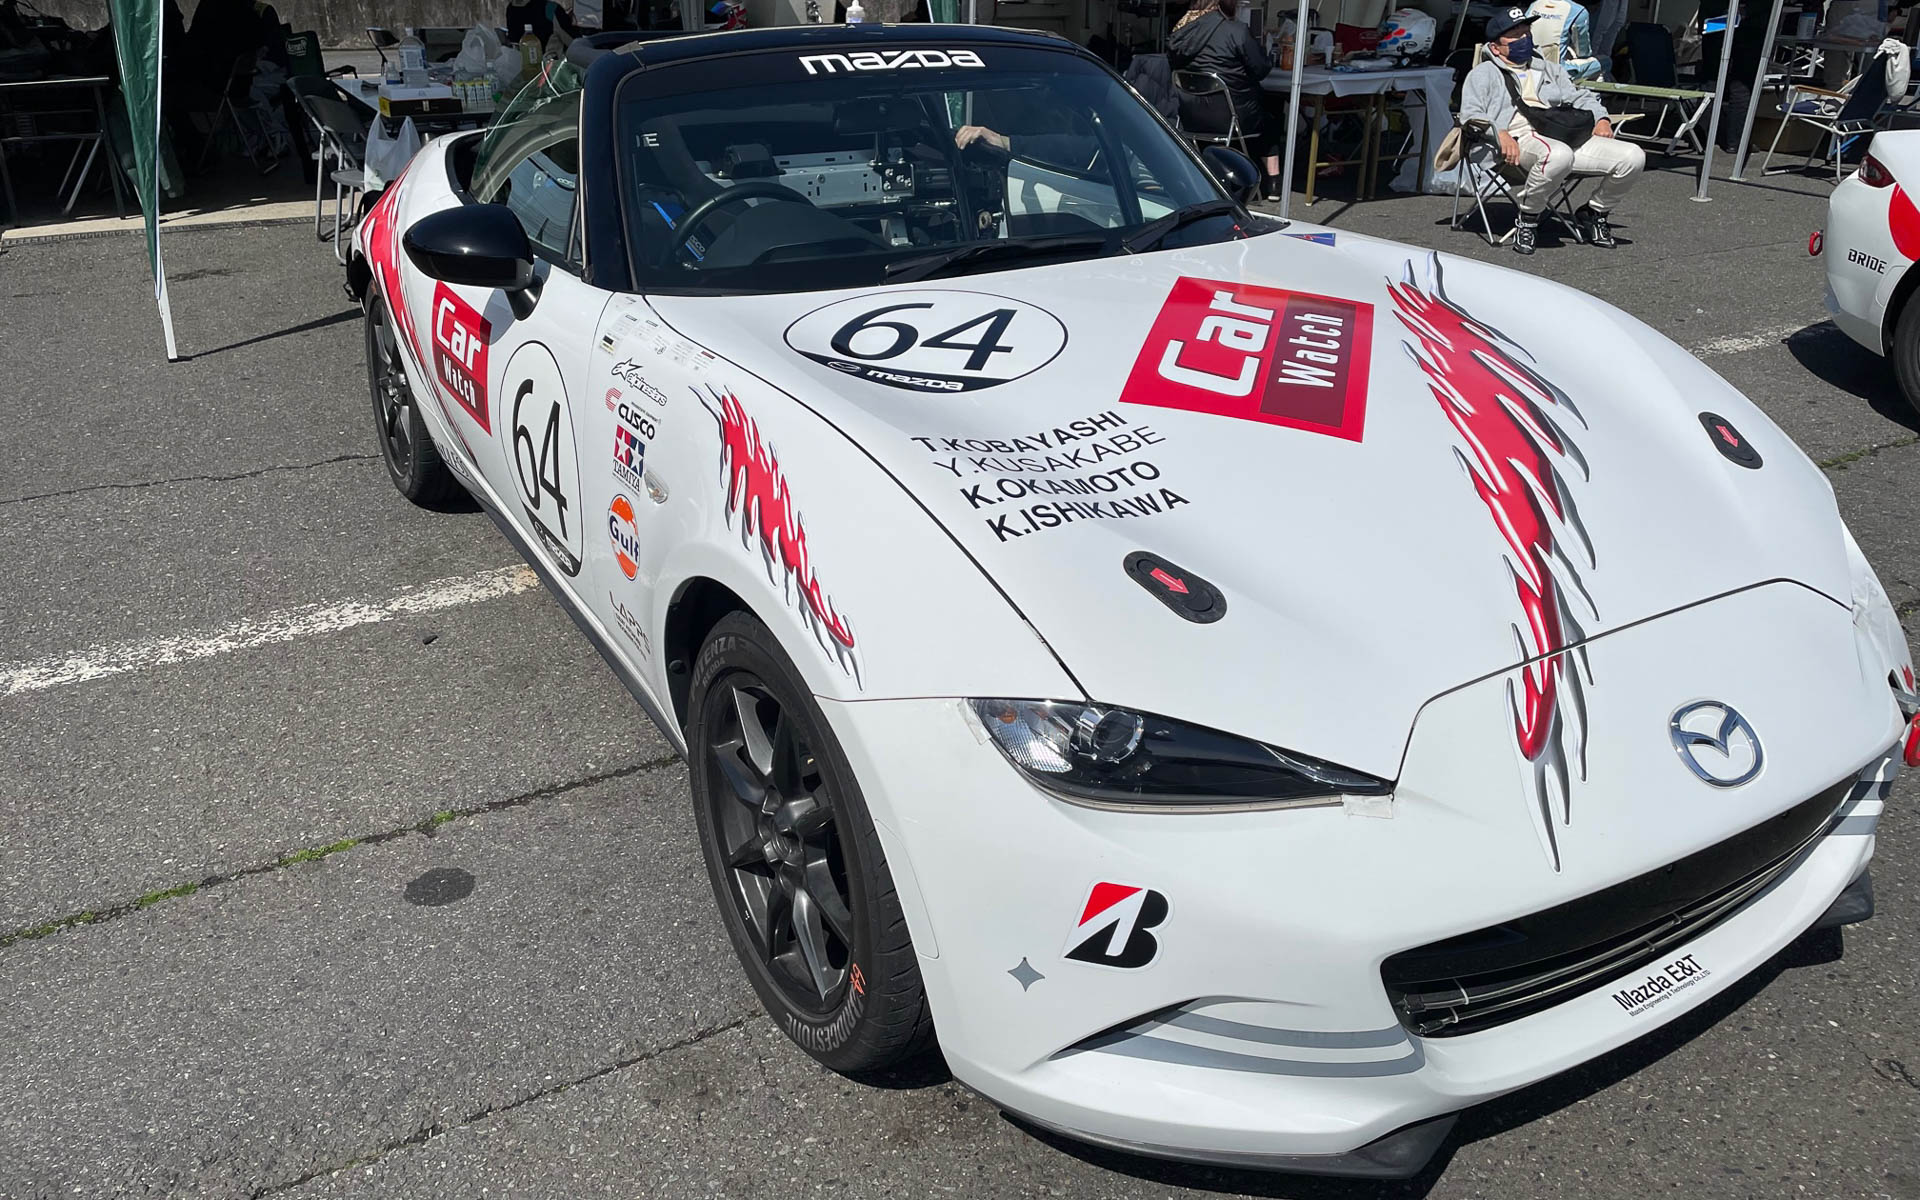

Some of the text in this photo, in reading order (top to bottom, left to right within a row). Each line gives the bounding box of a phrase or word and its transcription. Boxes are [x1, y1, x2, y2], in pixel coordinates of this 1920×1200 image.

[798, 50, 986, 75] mazda
[1847, 248, 1888, 275] BRIDE
[436, 297, 482, 371] Car
[830, 302, 1018, 371] 64
[1157, 290, 1275, 397] Car
[1277, 312, 1344, 388] Watch
[442, 353, 477, 409] Watch
[866, 369, 964, 392] mazda
[618, 403, 656, 441] CUSCO
[911, 410, 1128, 453] T.KOBAYASHI
[512, 378, 569, 542] 64
[613, 458, 642, 493] TAMIYA
[960, 461, 1161, 509] K.OKAMOTO
[609, 514, 640, 562] Gulf
[985, 487, 1191, 543] K.ISHIKAWA
[1611, 953, 1703, 1011] Mazda E&T
[785, 983, 864, 1053] BRIDGESTONE
